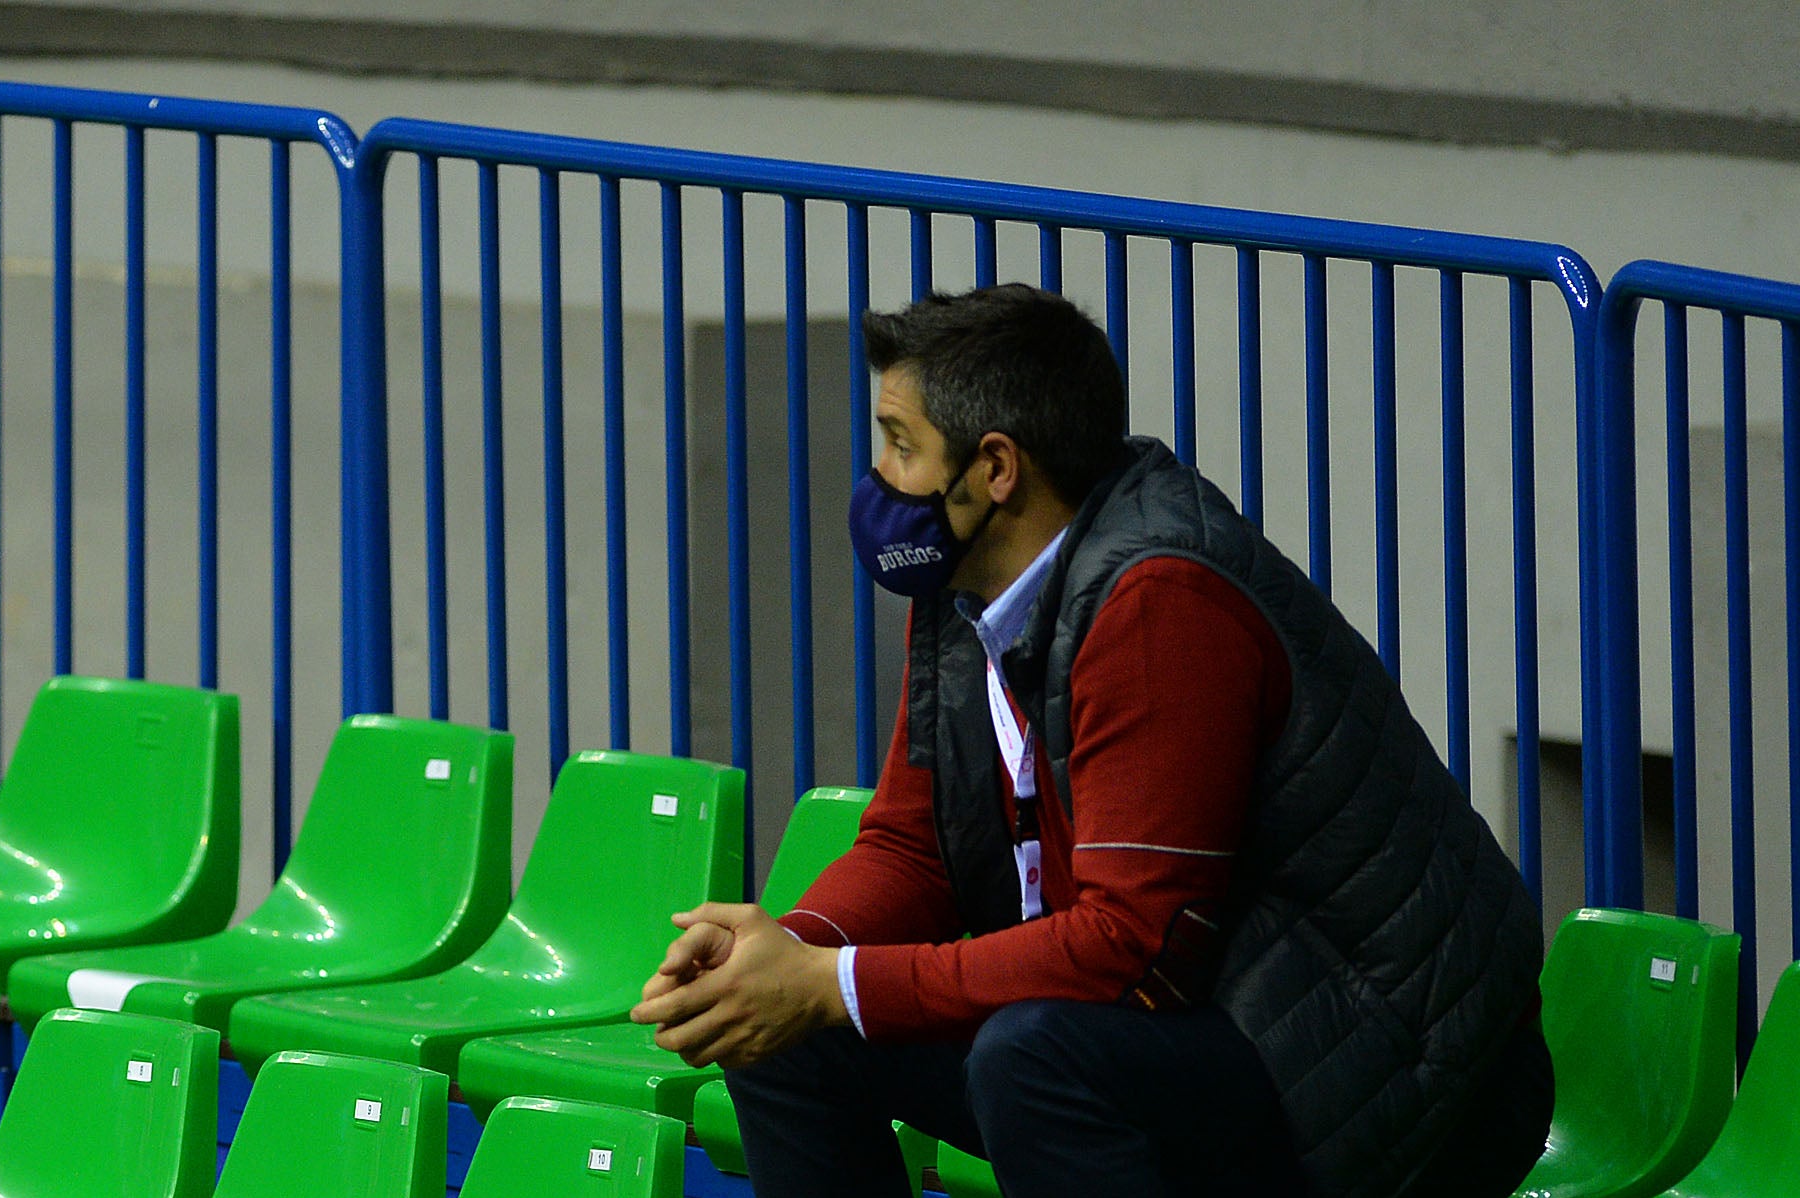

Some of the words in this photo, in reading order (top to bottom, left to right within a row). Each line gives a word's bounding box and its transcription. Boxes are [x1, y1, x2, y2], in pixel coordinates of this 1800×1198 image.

[877, 546, 943, 572] BURGOS
[1662, 963, 1669, 975] 11
[367, 1104, 372, 1115] 9
[598, 1153, 606, 1165] 10
